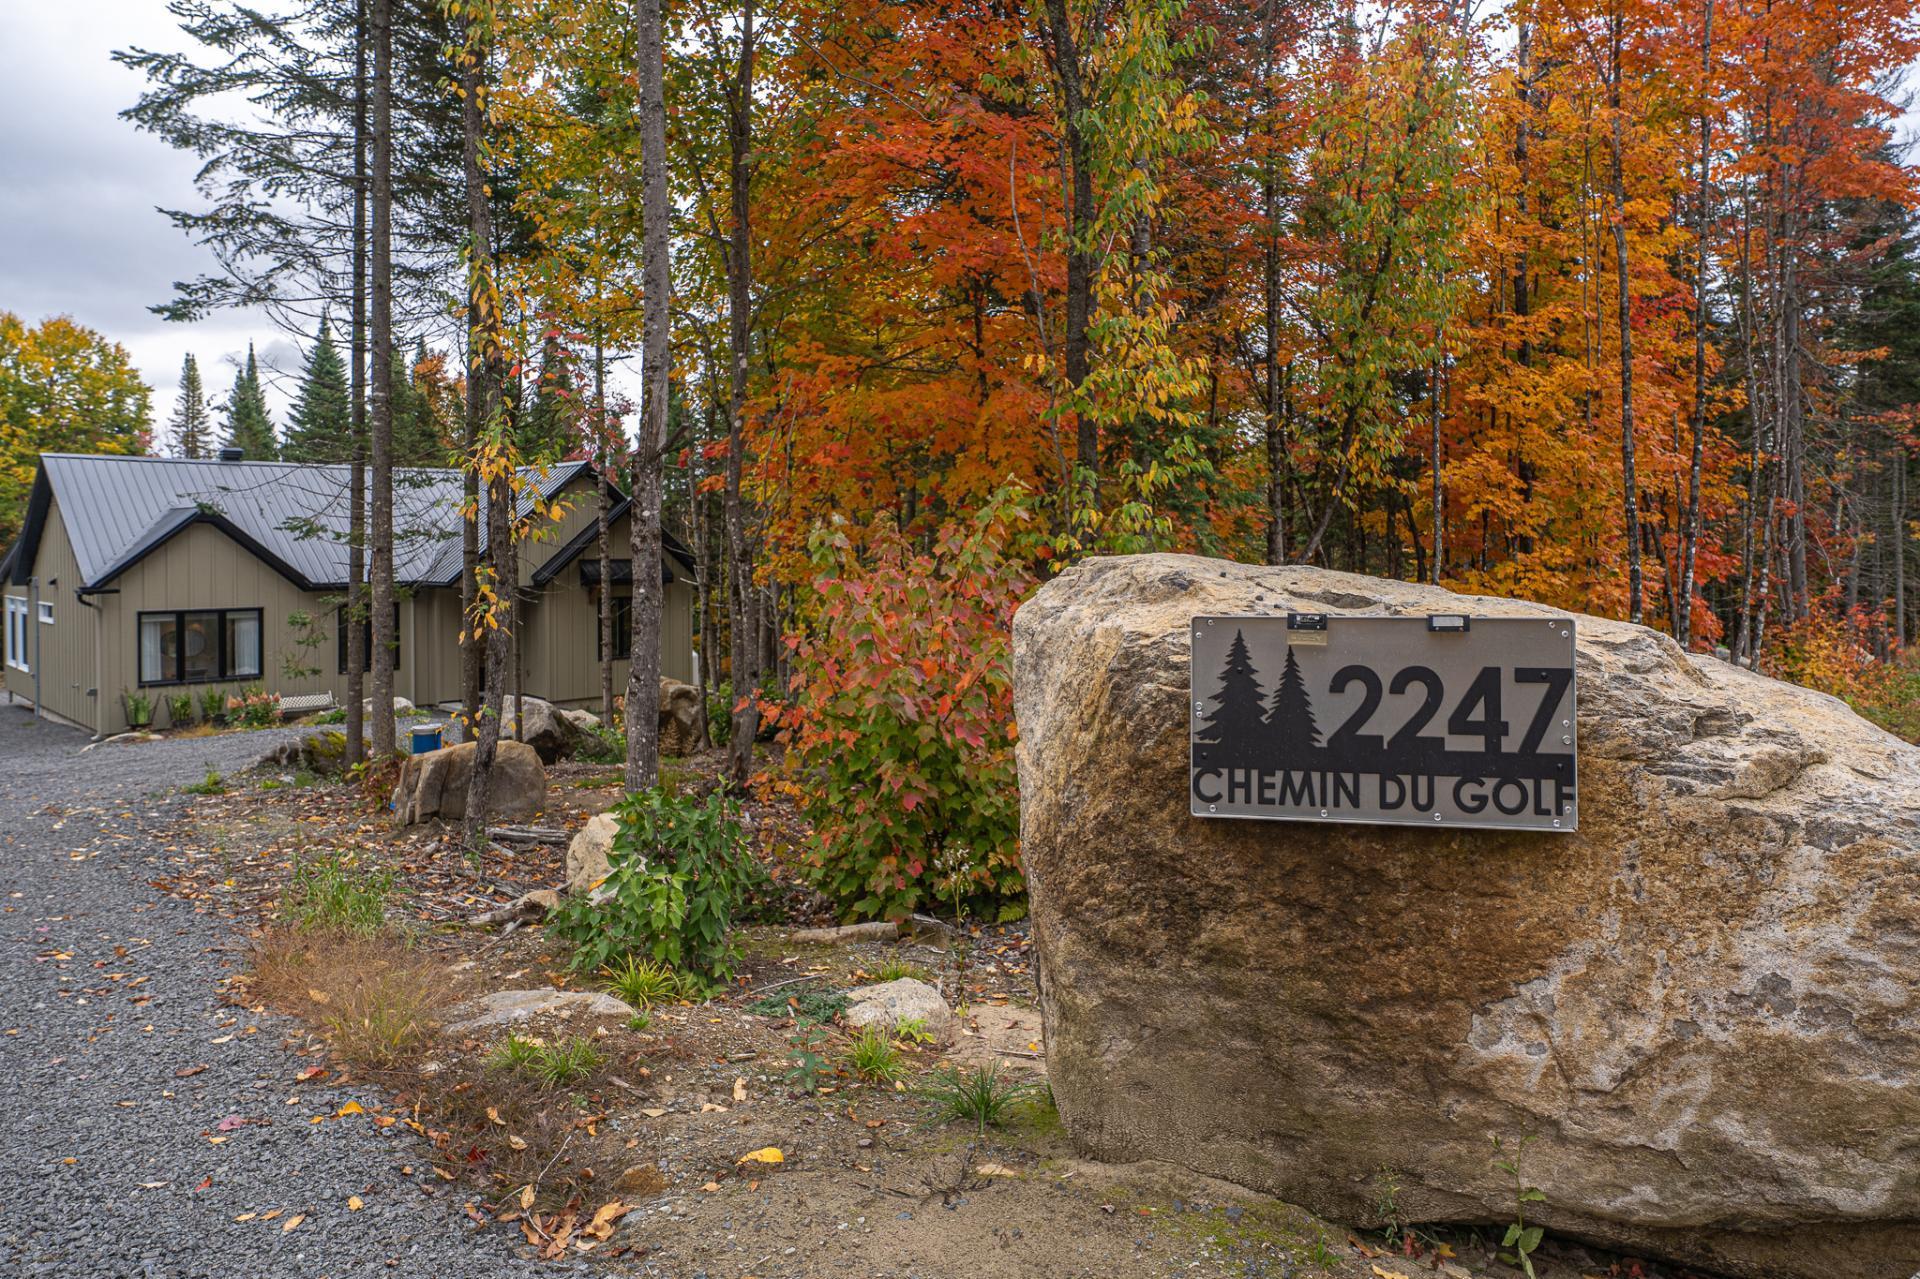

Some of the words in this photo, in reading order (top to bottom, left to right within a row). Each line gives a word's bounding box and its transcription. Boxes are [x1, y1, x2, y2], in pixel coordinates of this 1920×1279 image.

[1327, 664, 1573, 755] 2247
[1192, 768, 1361, 809] CHEMIN
[1379, 774, 1436, 812] DU
[1453, 777, 1575, 817] GOLF
